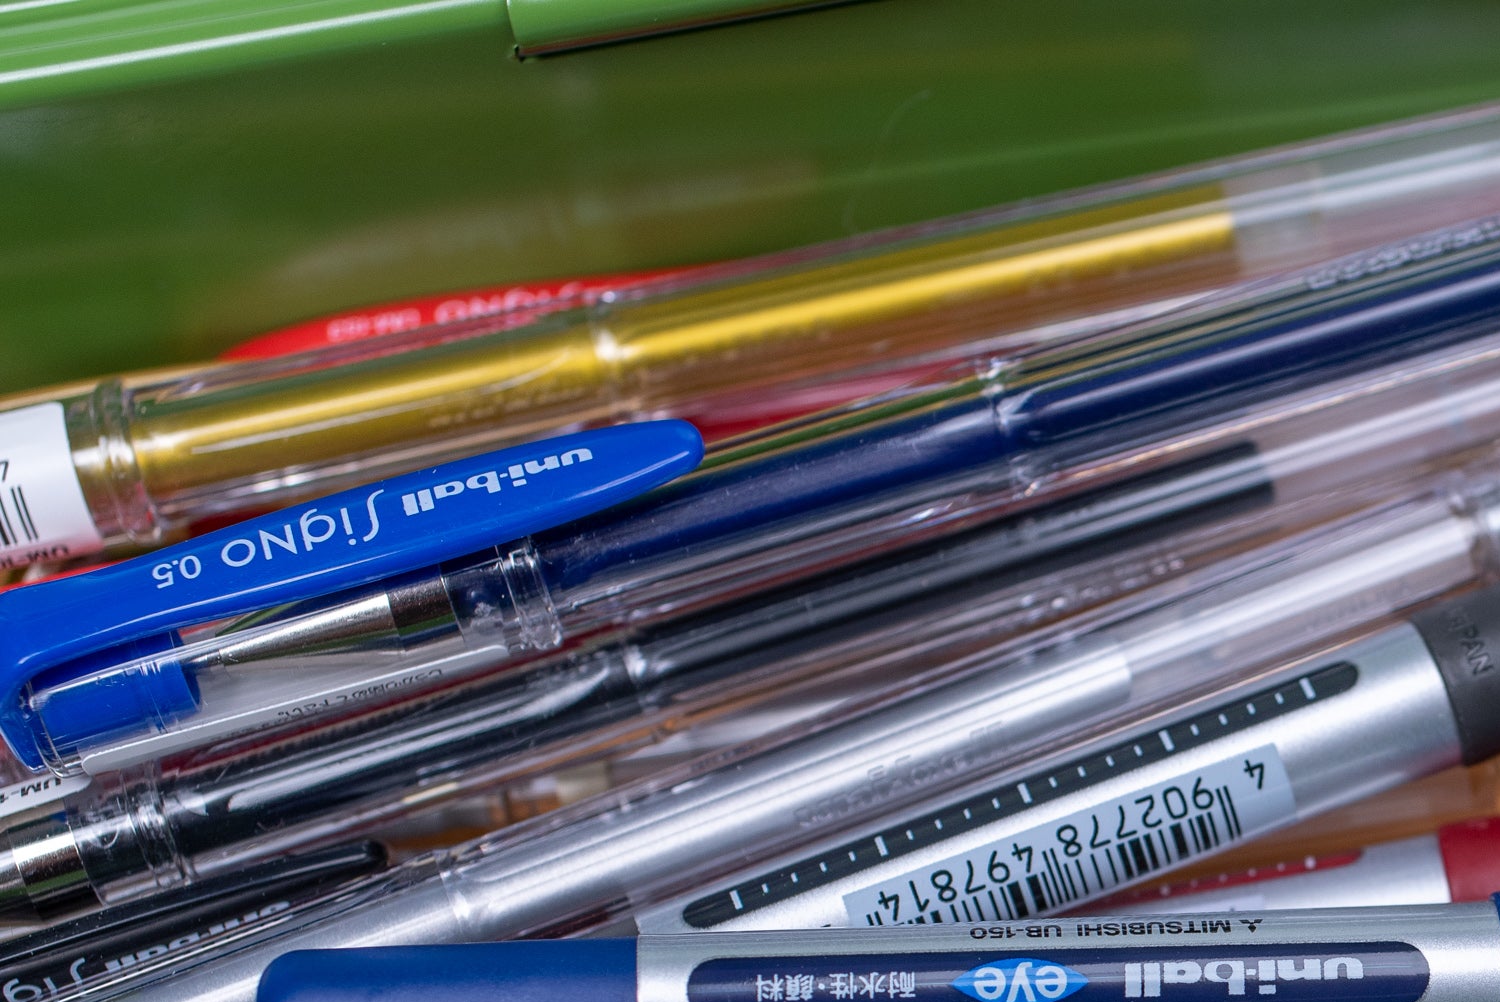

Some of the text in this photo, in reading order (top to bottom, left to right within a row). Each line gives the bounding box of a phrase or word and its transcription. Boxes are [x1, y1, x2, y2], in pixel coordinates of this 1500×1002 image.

[151, 554, 202, 589] 0.5
[877, 759, 1266, 922] 4 902778 497814
[969, 919, 1232, 940] MITSUBISHI UB-150
[973, 961, 1068, 1002] eye
